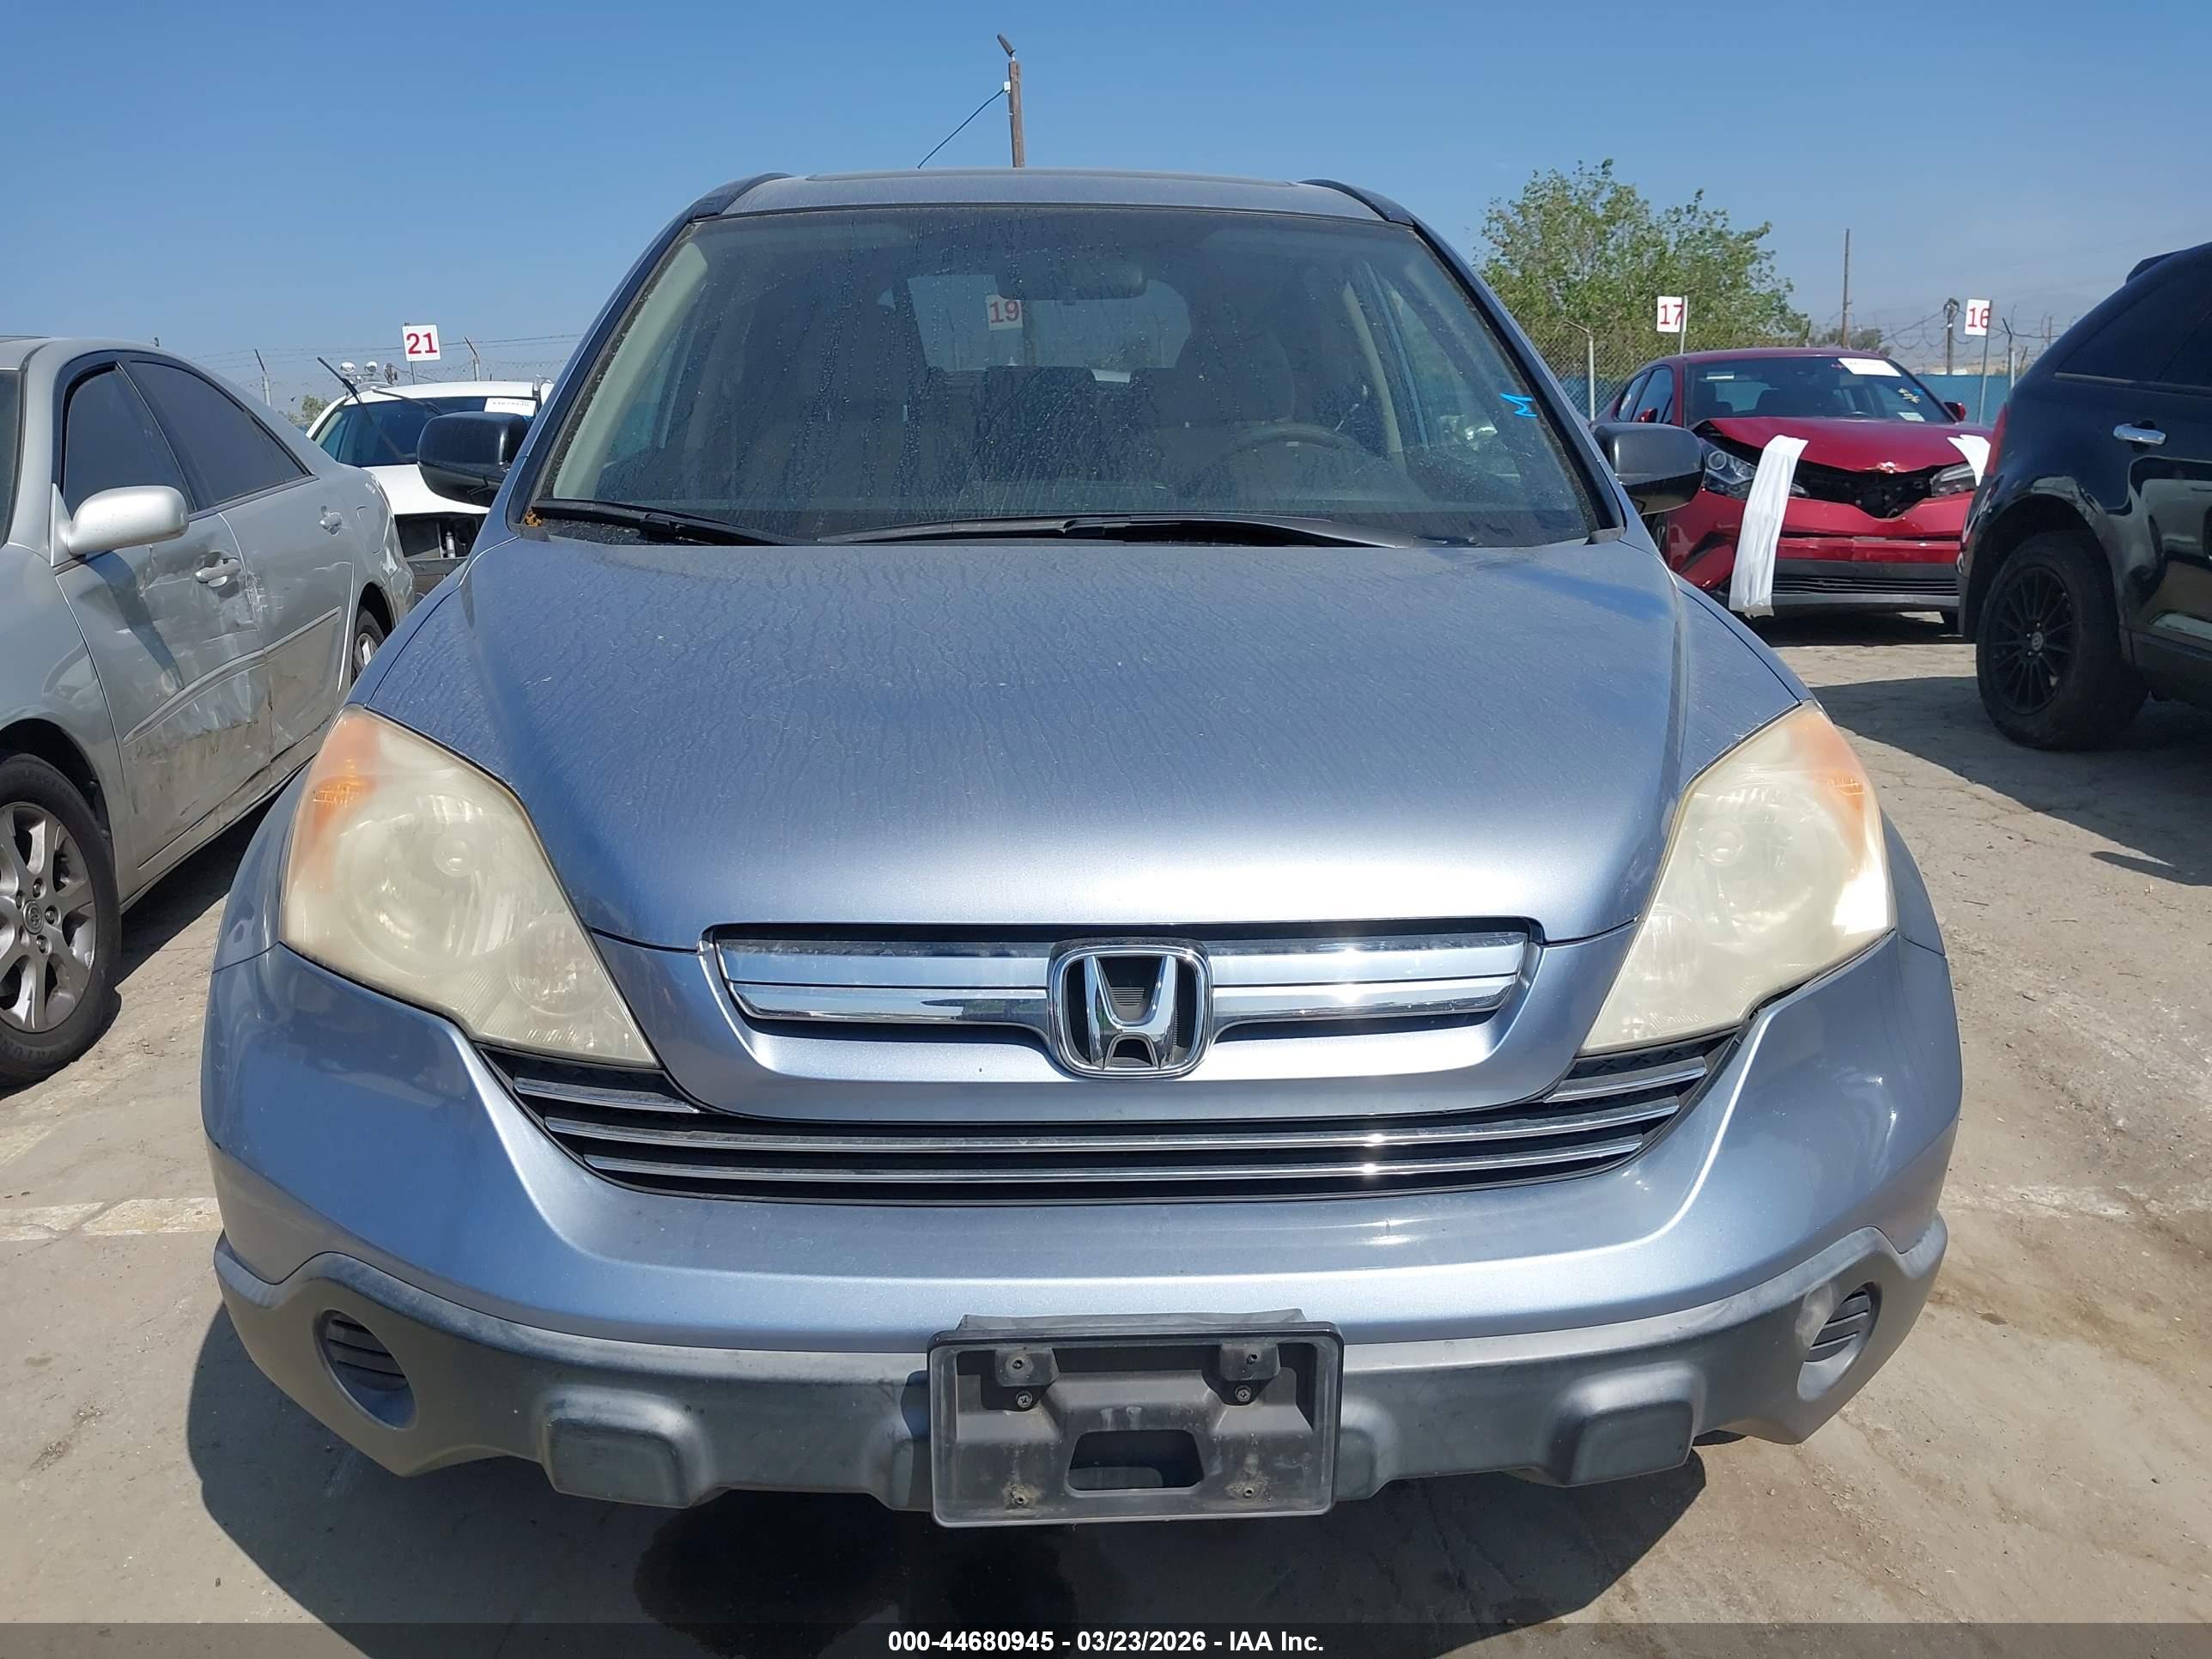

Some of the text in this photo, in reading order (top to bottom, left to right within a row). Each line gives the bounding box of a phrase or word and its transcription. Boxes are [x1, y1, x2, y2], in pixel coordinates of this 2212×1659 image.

[989, 301, 1019, 324] 19
[1660, 304, 1684, 325] 17
[406, 332, 437, 354] 21
